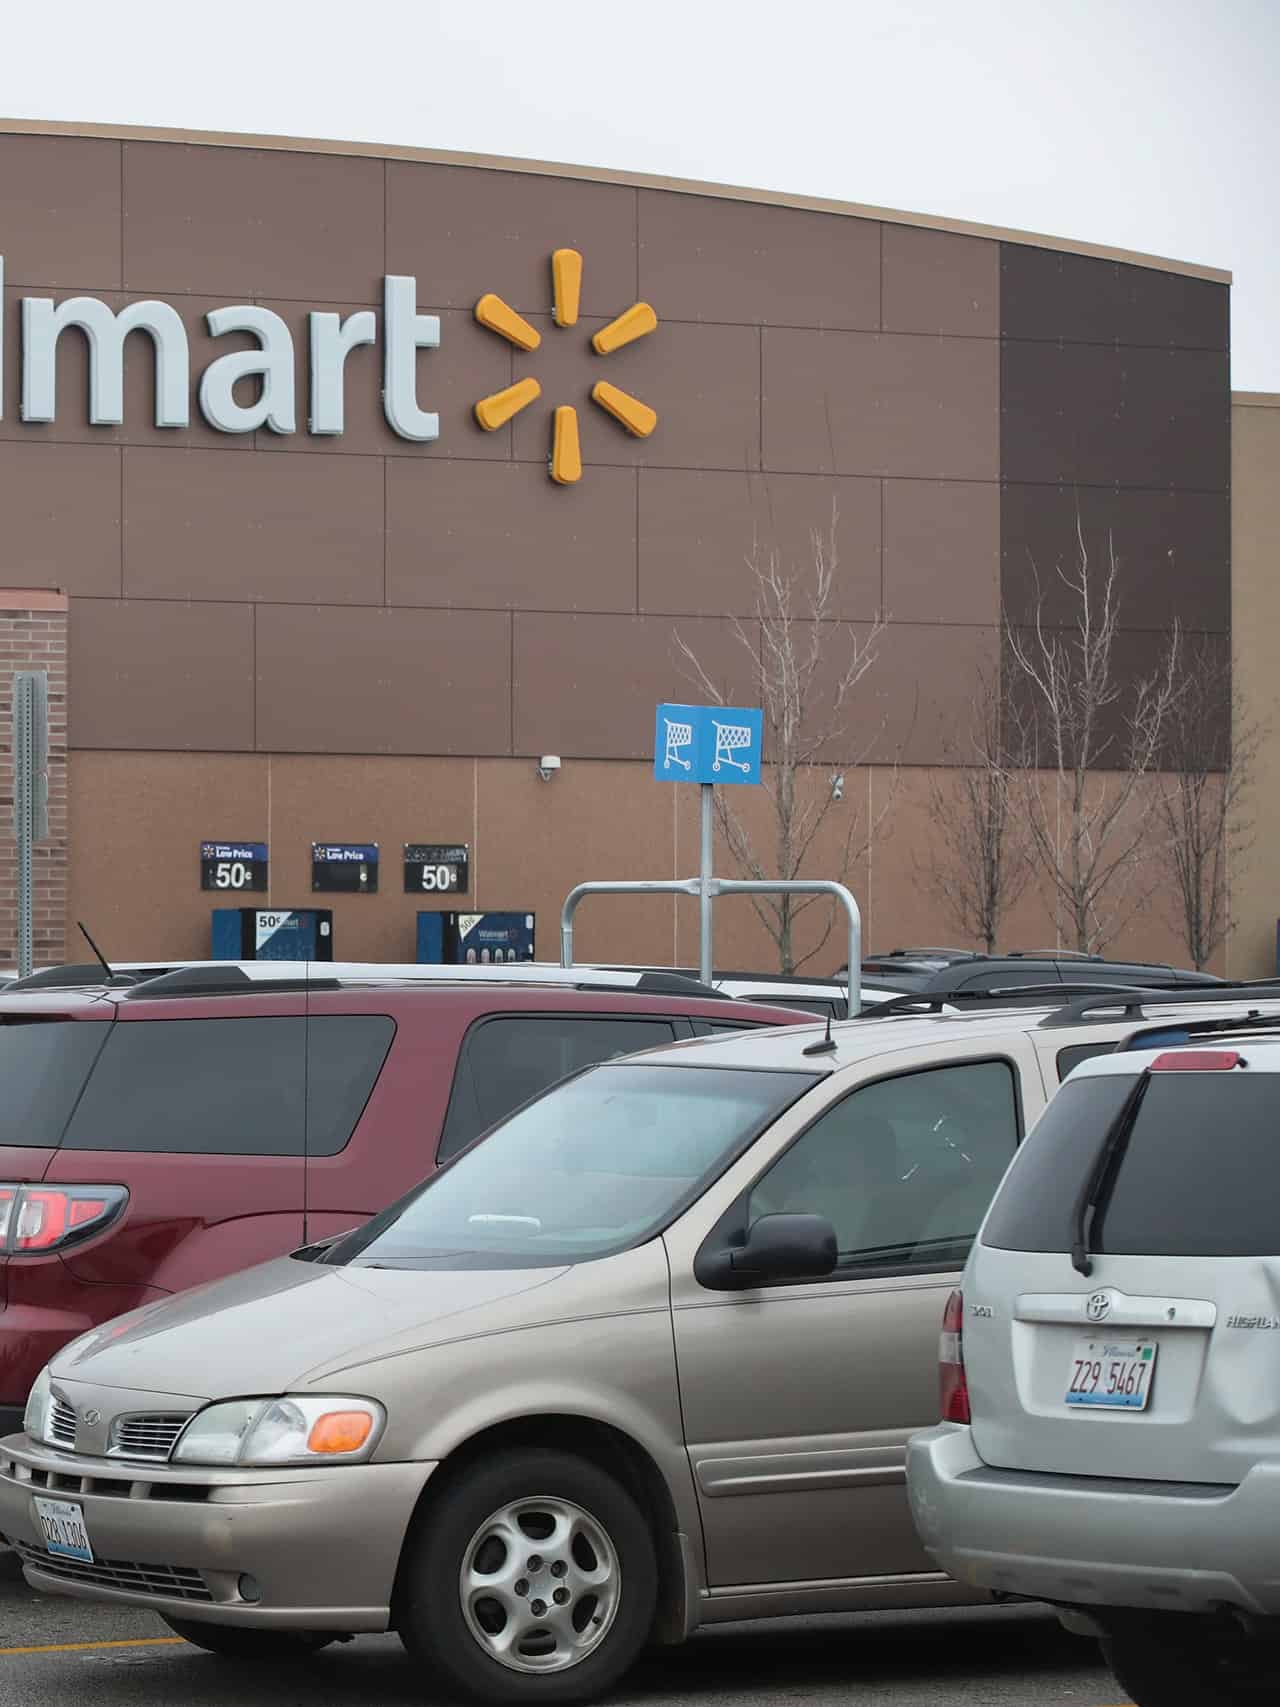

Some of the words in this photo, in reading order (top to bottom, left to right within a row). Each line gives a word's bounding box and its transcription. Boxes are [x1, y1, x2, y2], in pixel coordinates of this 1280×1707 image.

[216, 848, 232, 858] Low
[233, 848, 253, 859] Price
[326, 850, 343, 860] Low
[344, 850, 364, 860] Price
[479, 929, 509, 938] Walmart
[1070, 1360, 1101, 1393] Z29
[1107, 1362, 1146, 1395] 5467
